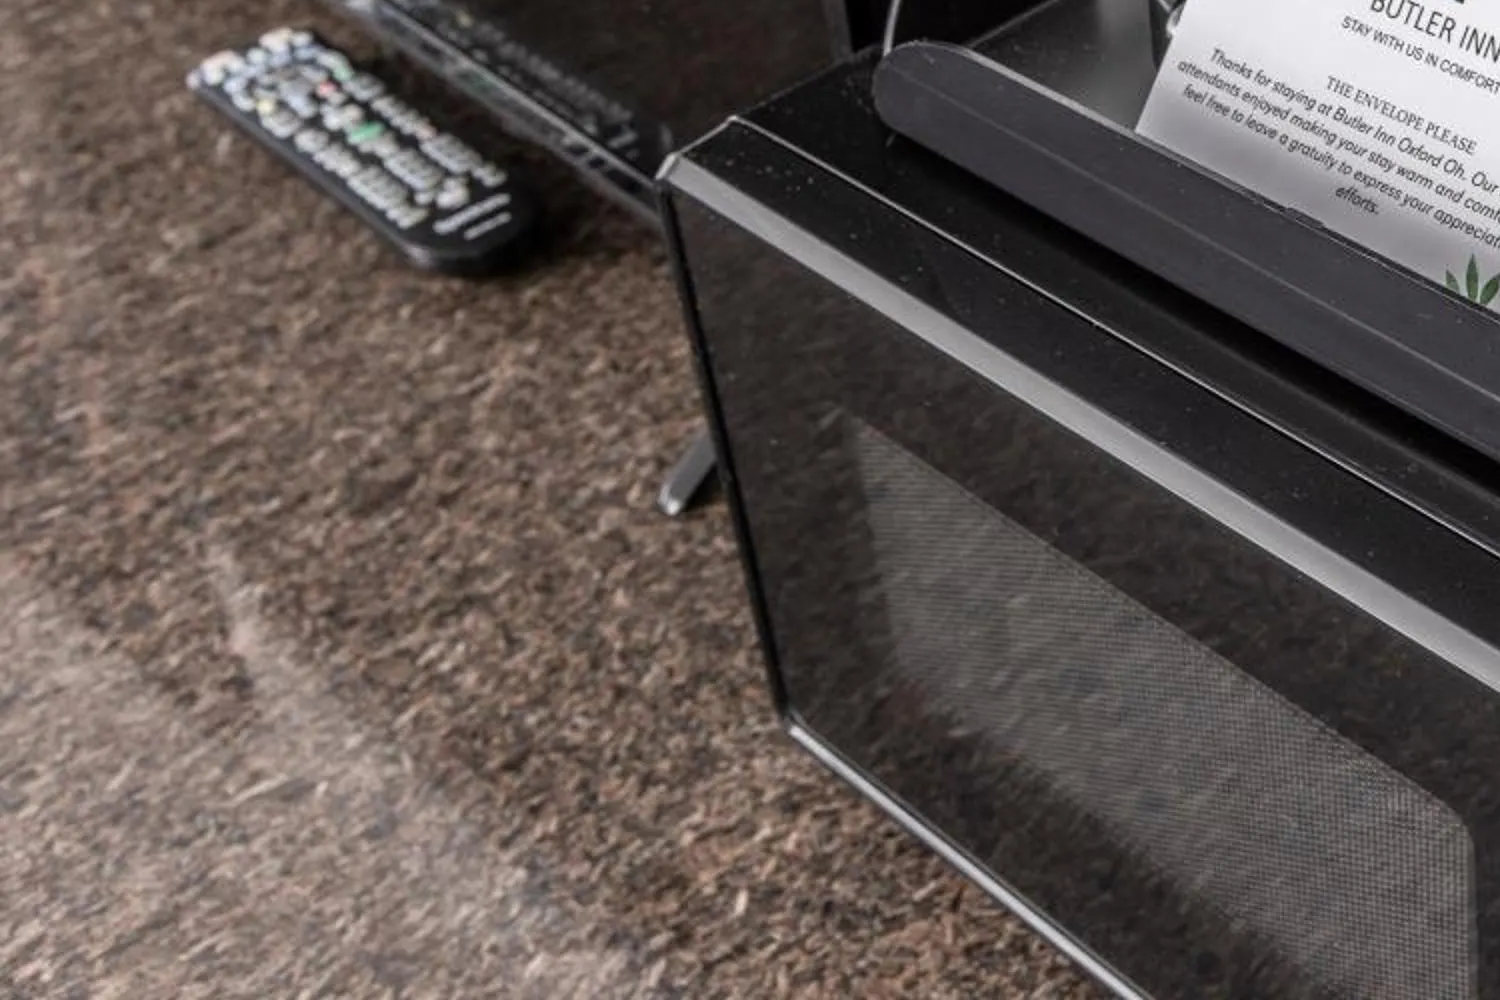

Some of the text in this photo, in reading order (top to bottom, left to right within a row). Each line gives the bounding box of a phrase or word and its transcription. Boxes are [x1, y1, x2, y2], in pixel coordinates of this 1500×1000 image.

[1341, 16, 1373, 37] STAY
[1373, 29, 1405, 52] WITH
[1405, 43, 1424, 61] US
[1425, 53, 1439, 67] IN
[1177, 60, 1241, 97] attendants
[1242, 91, 1290, 121] enjoyed
[1290, 114, 1337, 146] making
[1337, 138, 1368, 159] your
[1368, 150, 1395, 173] stay
[1396, 166, 1434, 189] warm
[1435, 183, 1464, 203] and
[1183, 83, 1205, 104] feel
[1205, 95, 1231, 117] free
[1231, 110, 1244, 123] to
[1245, 117, 1278, 139] leave
[1279, 134, 1289, 145] a
[1289, 139, 1338, 170] gratuity
[1338, 162, 1353, 176] to
[1354, 171, 1402, 201] express
[1401, 194, 1434, 215] your
[1210, 47, 1253, 79] Thanks
[1254, 69, 1272, 87] for
[1272, 81, 1317, 110] staying
[1317, 102, 1332, 116] at
[1333, 107, 1374, 134] Butler
[1374, 125, 1396, 146] Inn
[1398, 137, 1442, 168] Oxford
[1443, 158, 1467, 181] Oh.
[1471, 171, 1500, 193] Our
[1326, 76, 1477, 156] THE ENVELOPE PLEASE
[1335, 187, 1379, 215] efforts.
